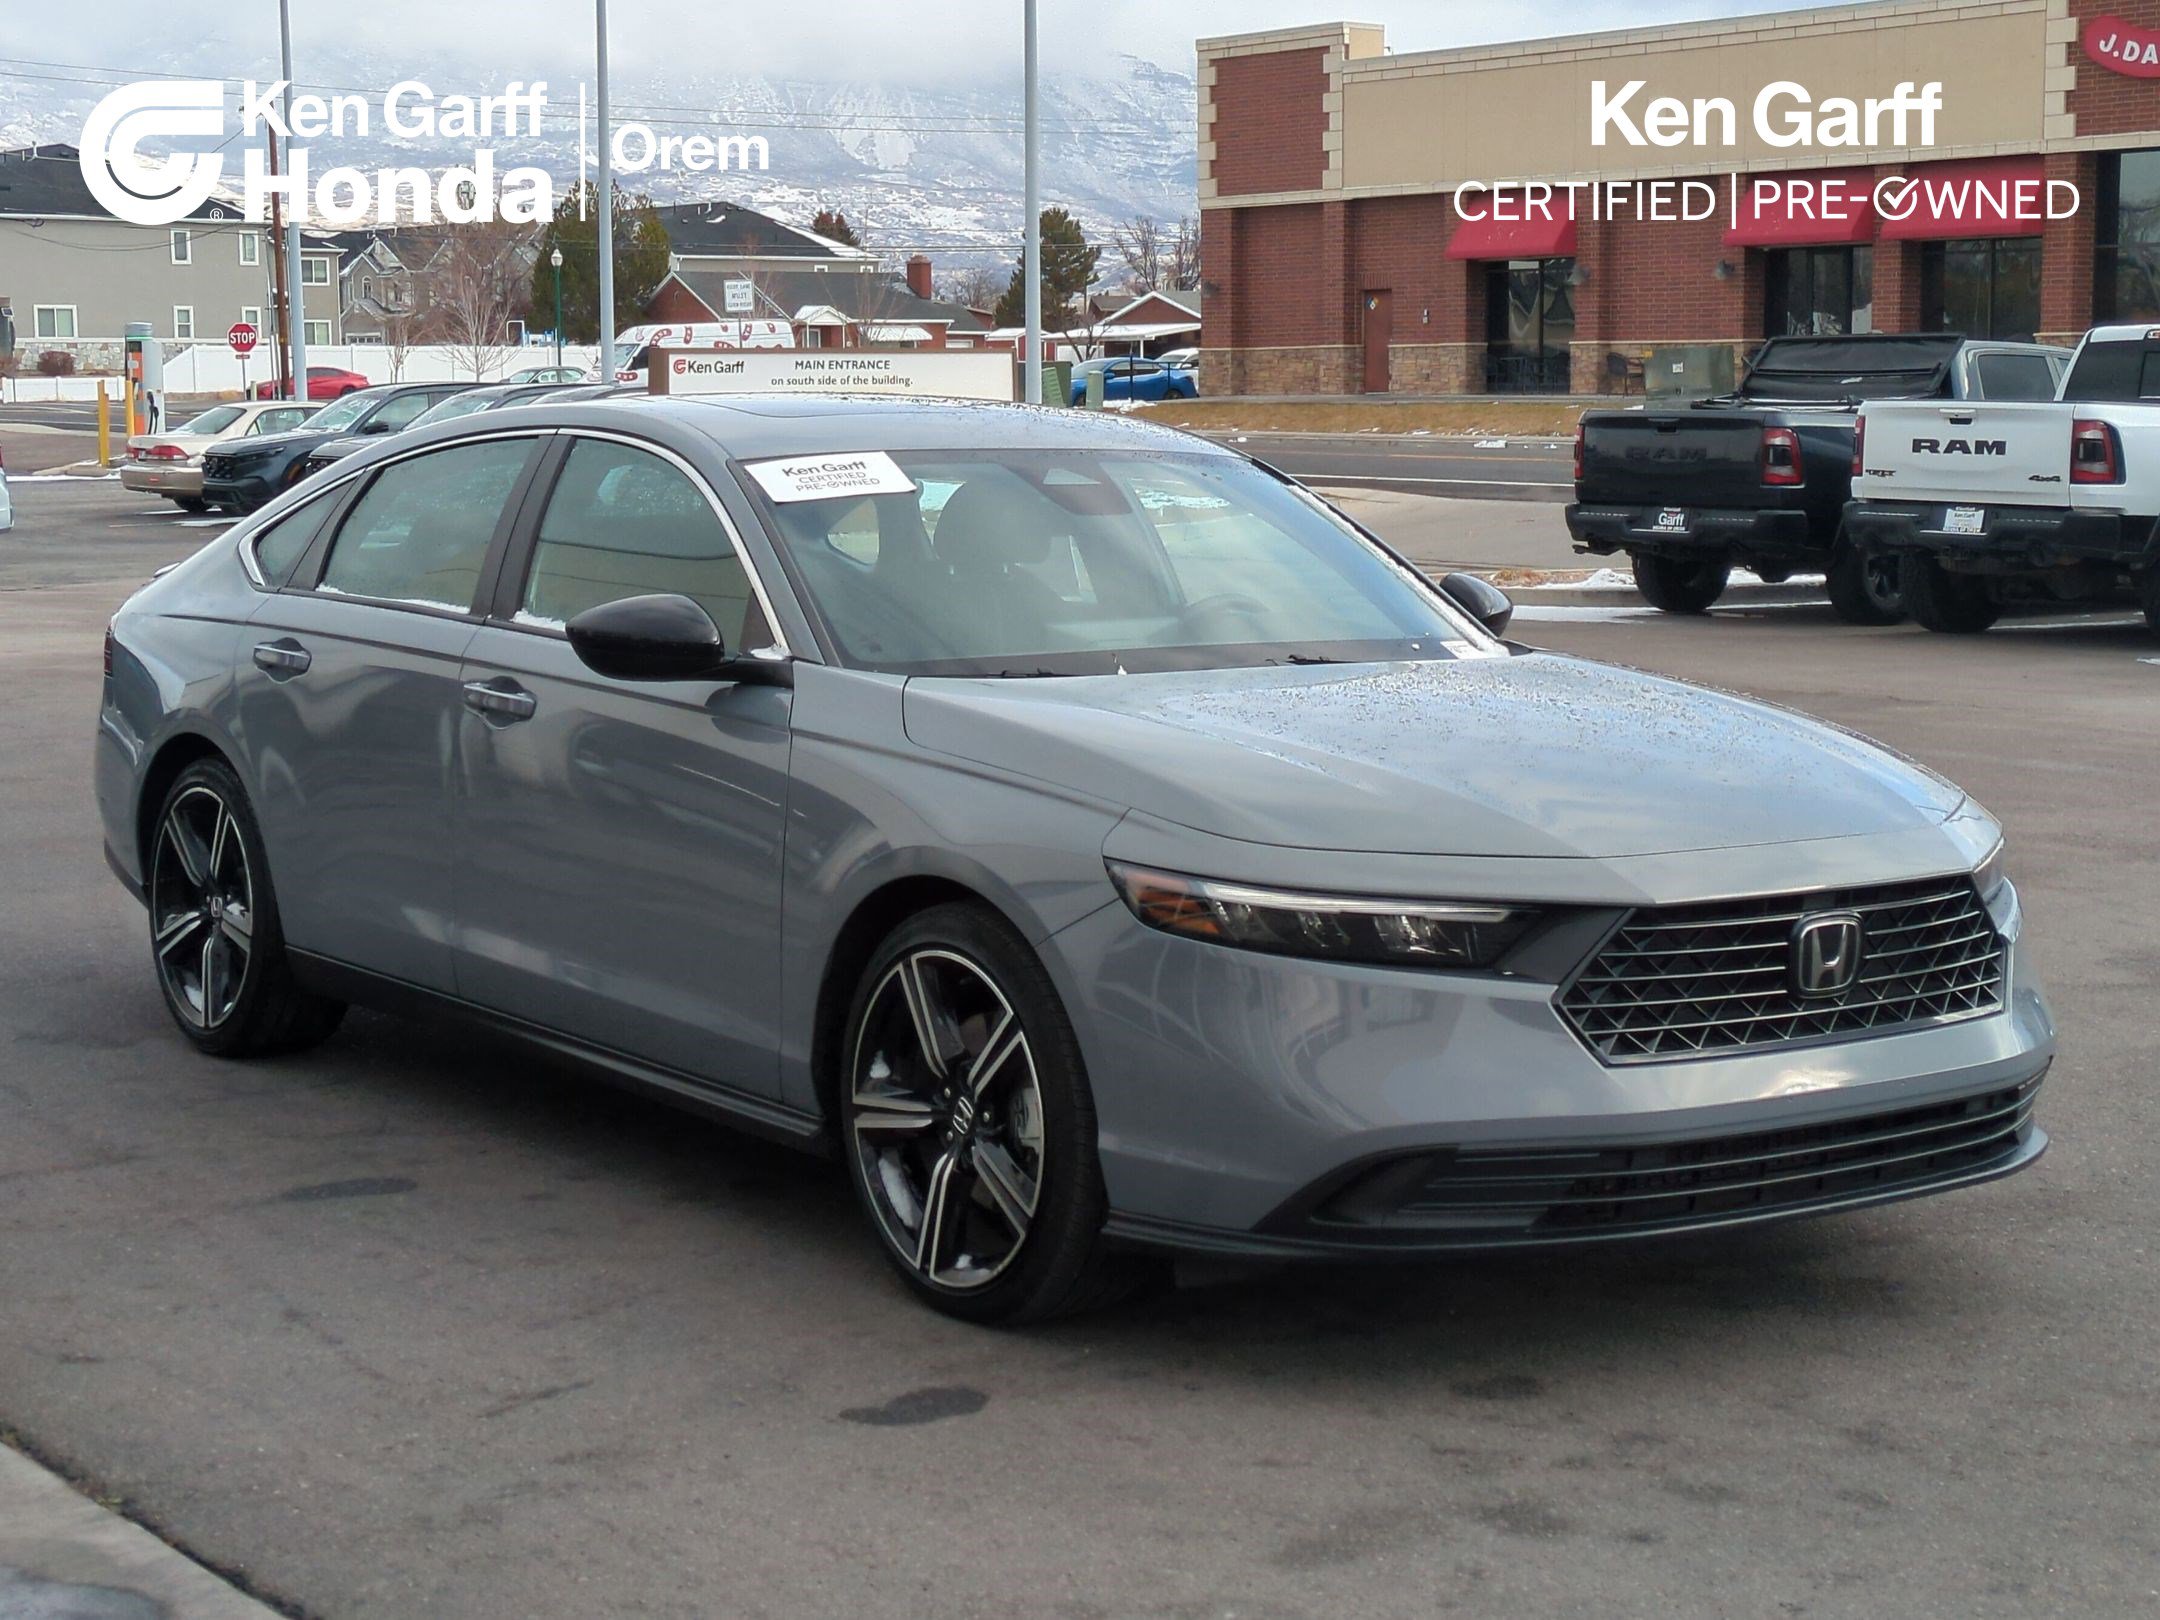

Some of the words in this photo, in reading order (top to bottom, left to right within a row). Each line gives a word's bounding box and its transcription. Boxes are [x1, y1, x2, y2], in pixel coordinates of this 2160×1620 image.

[230, 332, 255, 344] STOP
[688, 360, 712, 373] Ken
[714, 360, 745, 373] Garff
[794, 360, 825, 370] MAIN
[828, 360, 890, 370] ENTRANCE
[771, 377, 784, 385] on
[787, 375, 815, 385] south
[818, 375, 837, 385] side
[840, 375, 850, 385] of
[853, 375, 869, 385] the
[872, 375, 913, 387] building.
[1625, 446, 1707, 461] RAM
[1912, 438, 2007, 456] RAM
[782, 465, 820, 477] Ken
[821, 460, 867, 472] Garff
[798, 471, 866, 484] CERTIFIED
[1658, 512, 1685, 526] Garff
